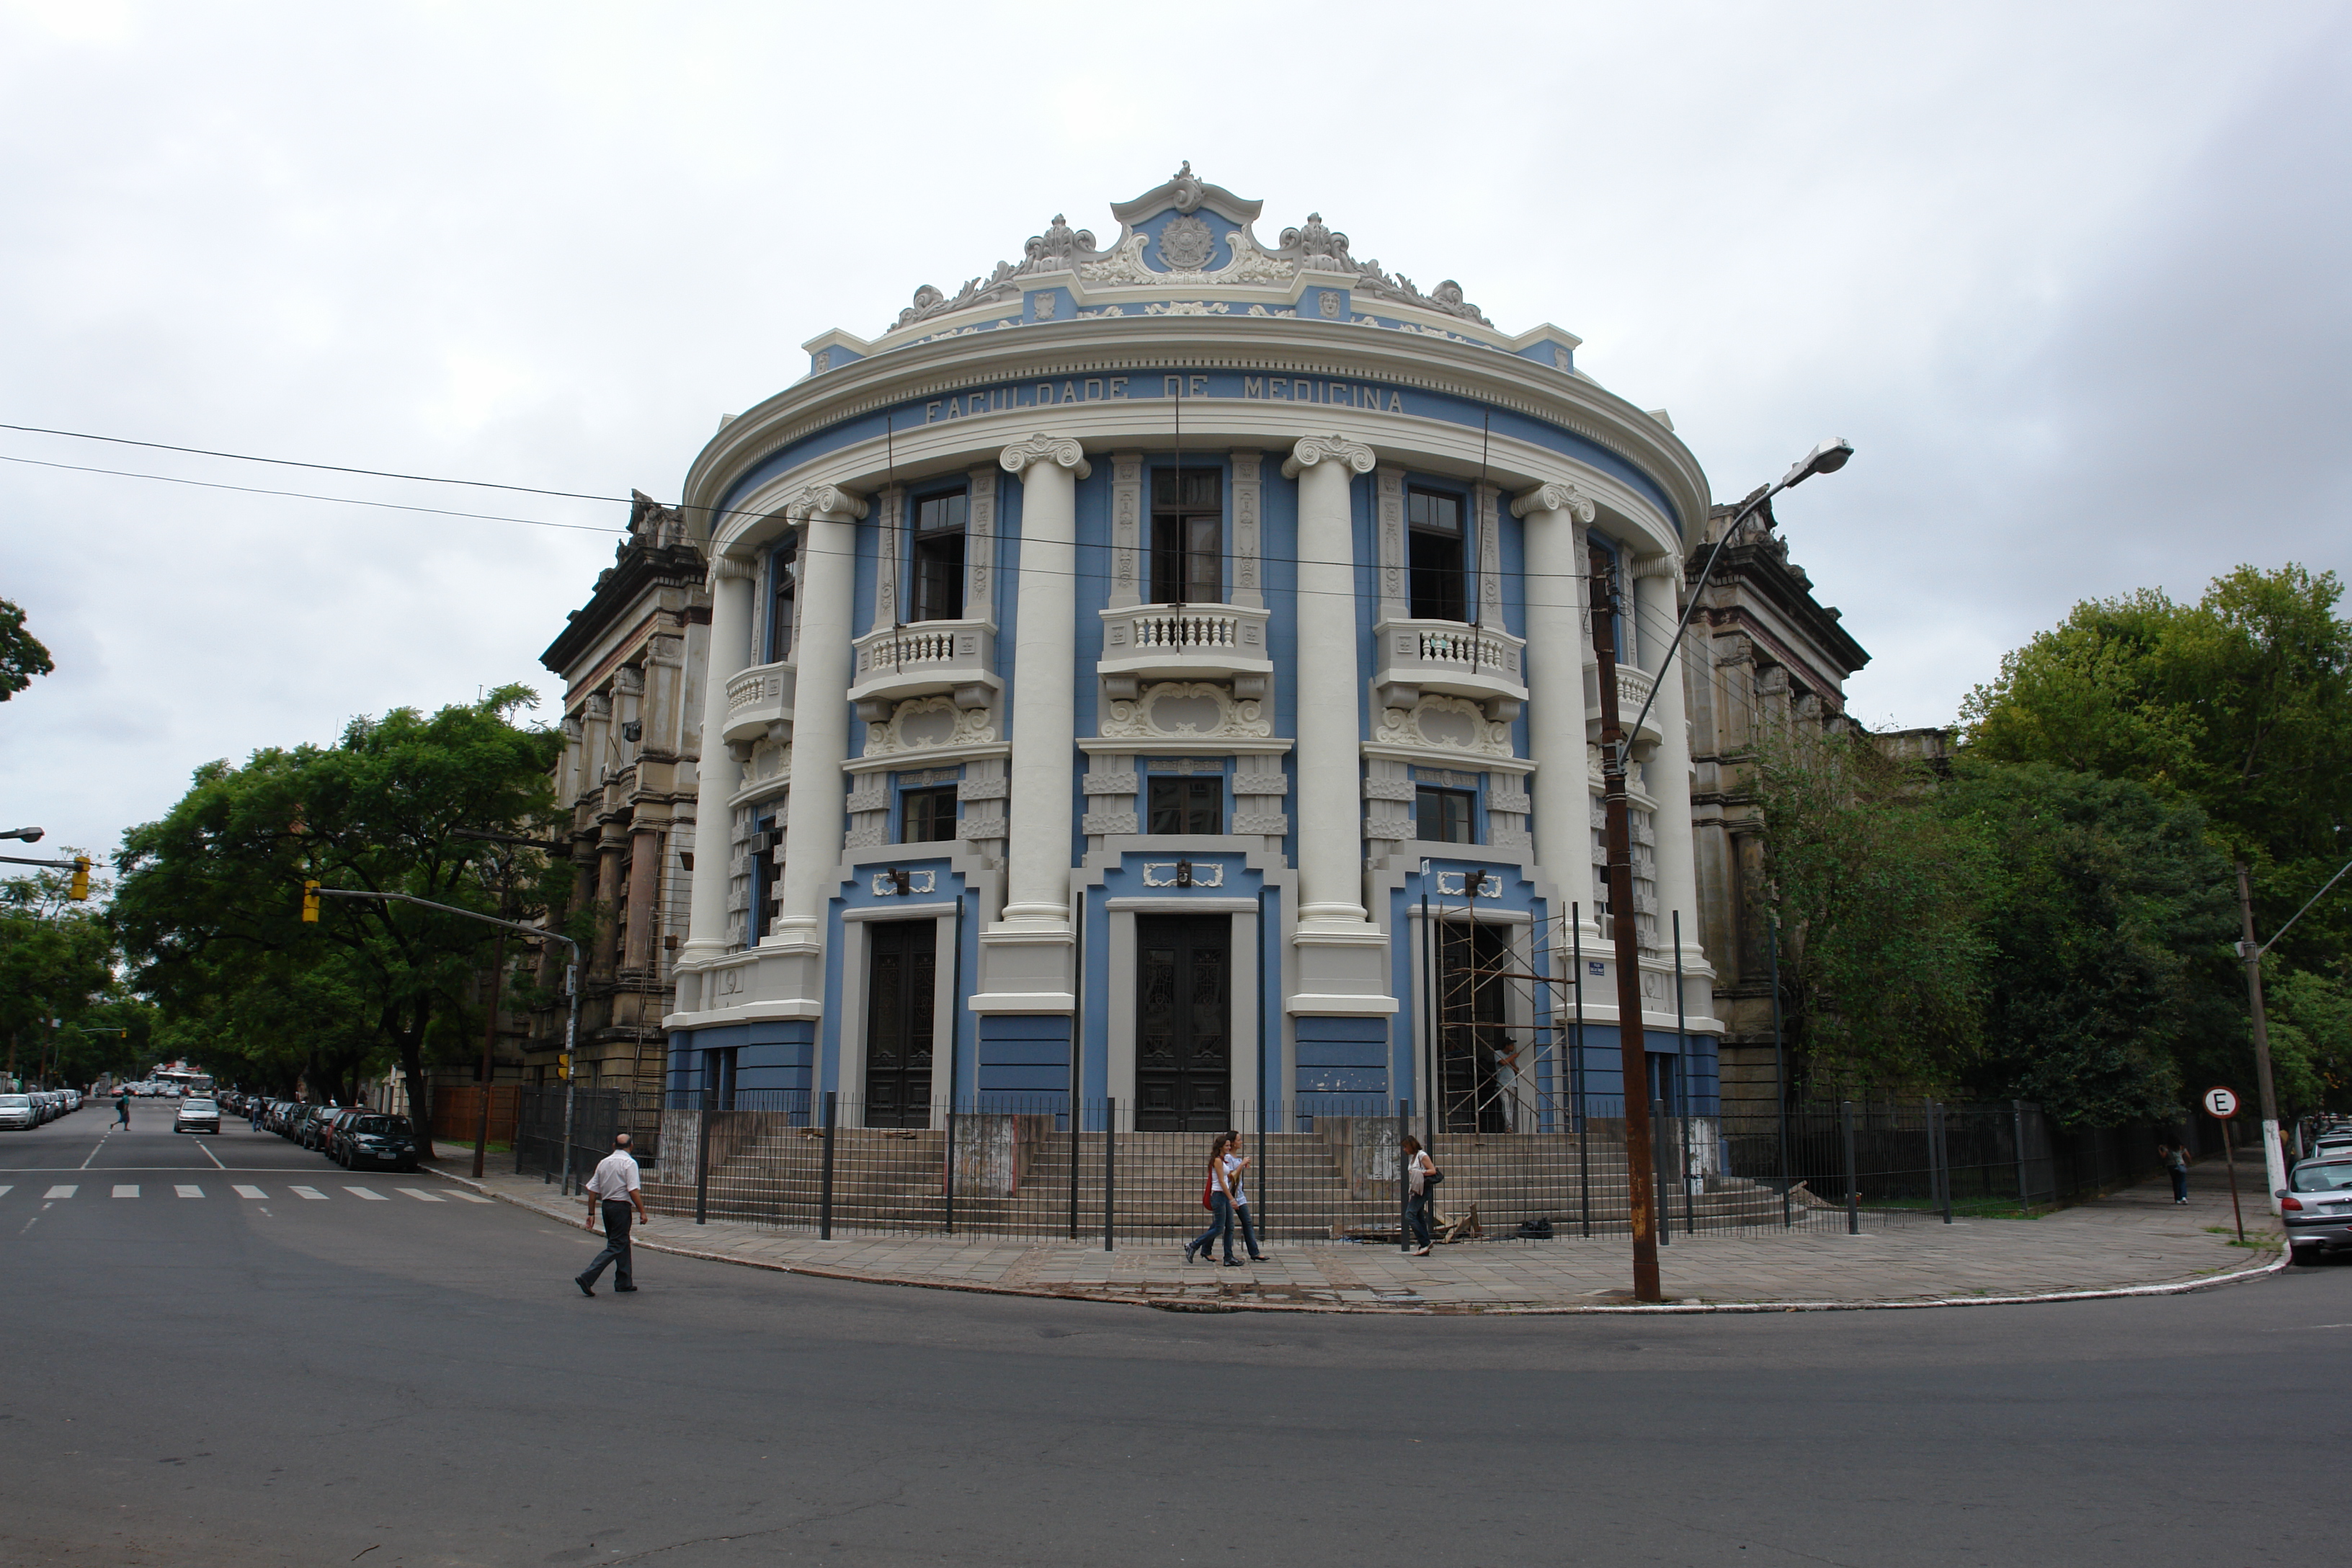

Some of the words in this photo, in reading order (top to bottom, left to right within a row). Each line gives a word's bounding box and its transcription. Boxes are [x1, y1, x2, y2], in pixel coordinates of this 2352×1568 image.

[926, 377, 1128, 424] FACULDADE
[1164, 375, 1208, 398] DE
[1244, 376, 1404, 414] MEDICINA
[2214, 1093, 2229, 1111] E
